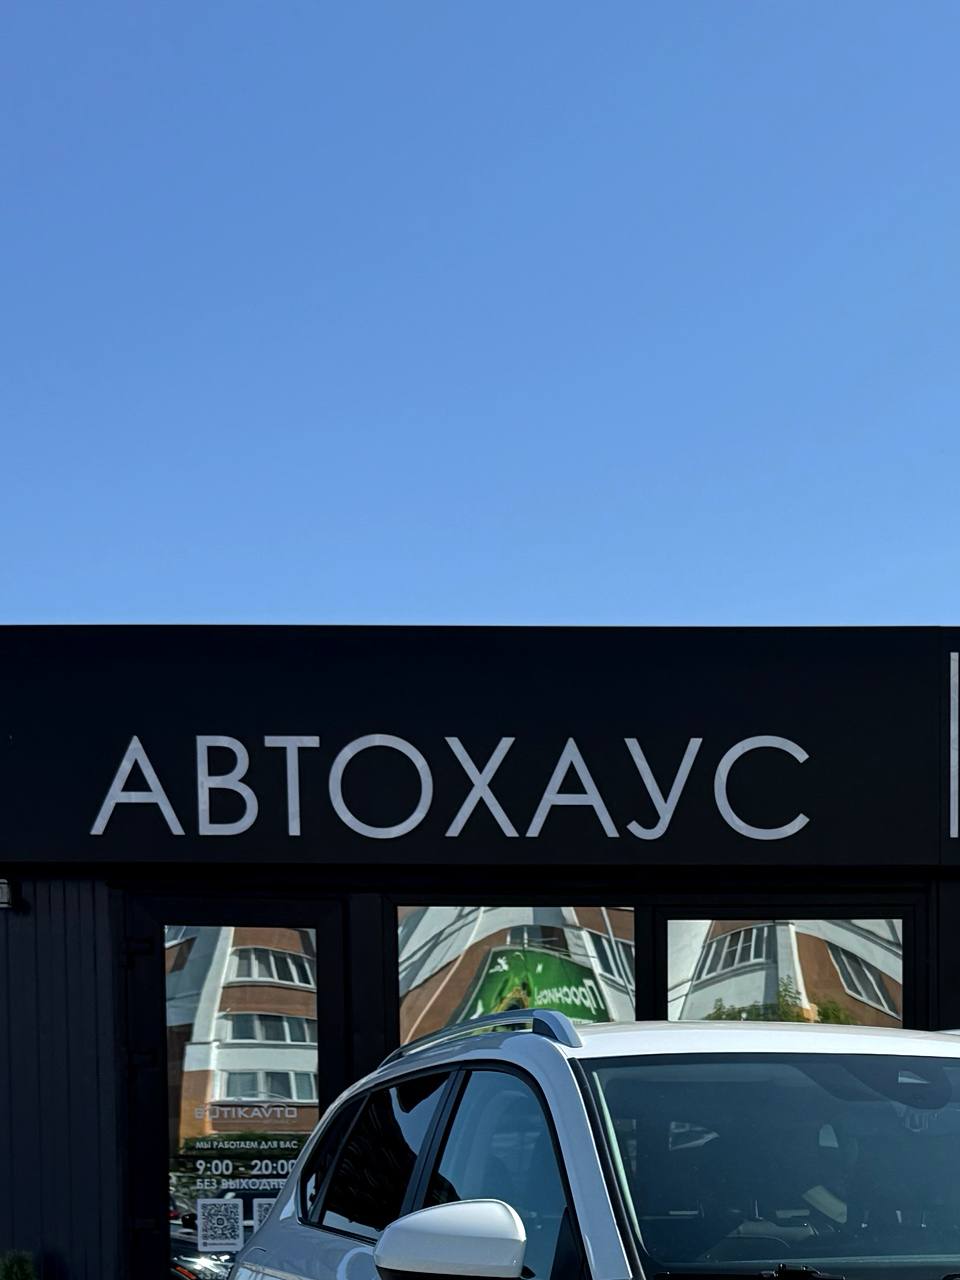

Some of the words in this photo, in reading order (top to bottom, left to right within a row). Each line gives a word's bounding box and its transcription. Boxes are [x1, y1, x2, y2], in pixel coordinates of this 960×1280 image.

[90, 734, 811, 840] АВТОХАУС
[194, 1106, 298, 1119] BUTIKAVTO
[213, 1141, 258, 1149] РАБОТАЕМ
[196, 1160, 233, 1175] 9:00
[196, 1179, 218, 1189] БЕЗ
